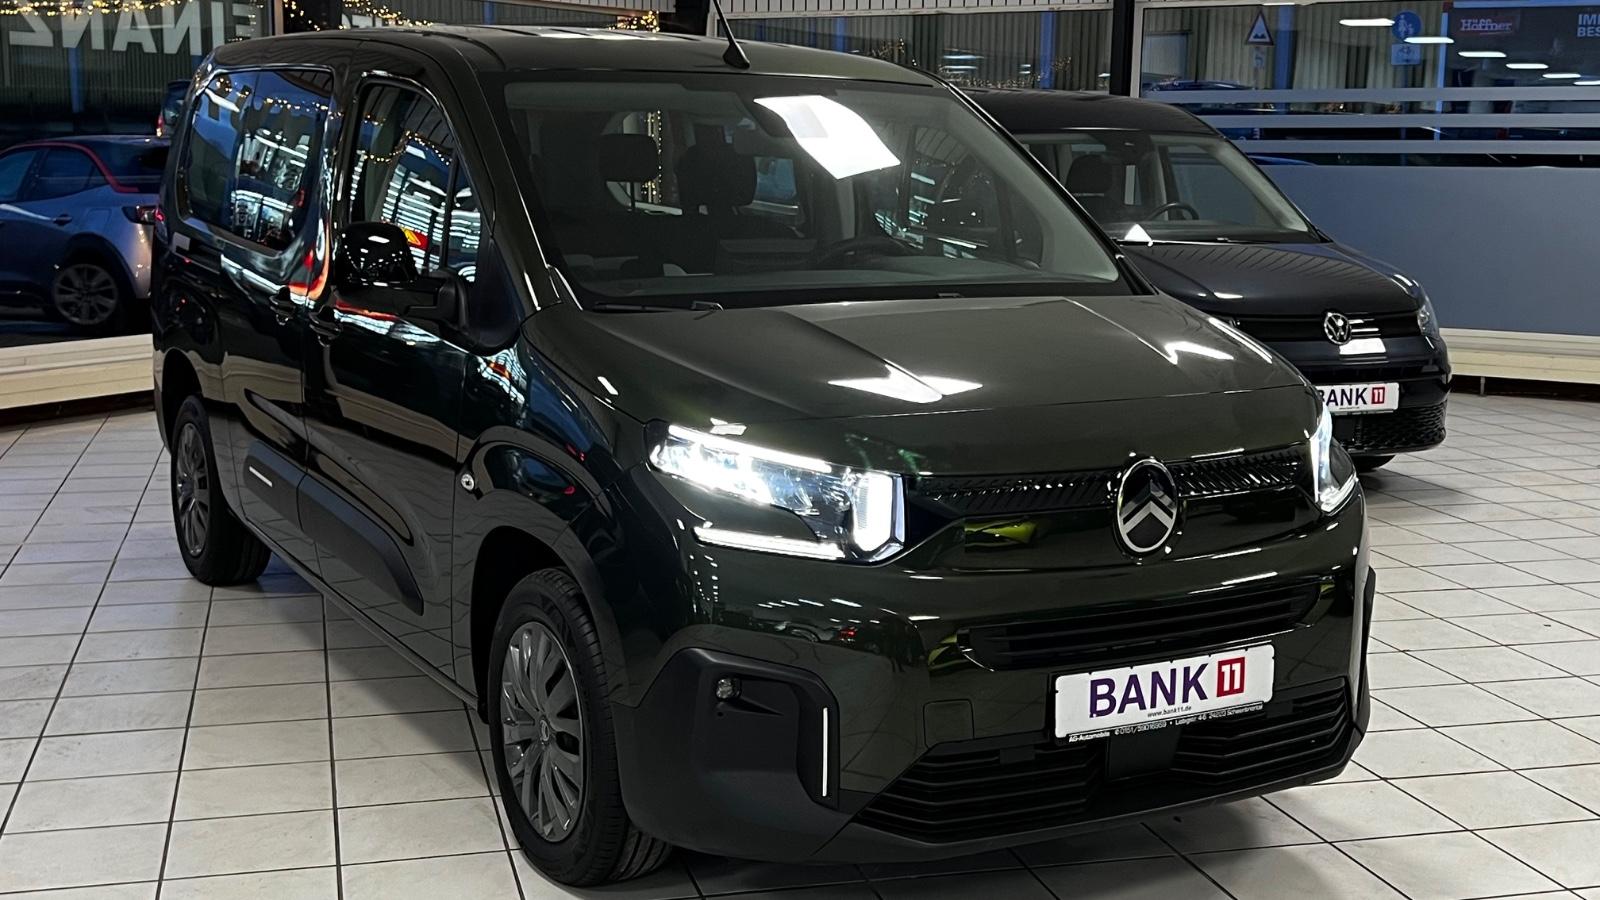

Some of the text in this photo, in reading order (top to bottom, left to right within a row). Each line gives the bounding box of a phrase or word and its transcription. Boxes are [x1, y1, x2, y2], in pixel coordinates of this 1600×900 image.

[1460, 18, 1513, 33] Höffner
[1578, 14, 1600, 25] IM
[1373, 388, 1385, 403] 11
[1089, 661, 1242, 718] BANK 11
[1147, 704, 1192, 718] www.bank11.de
